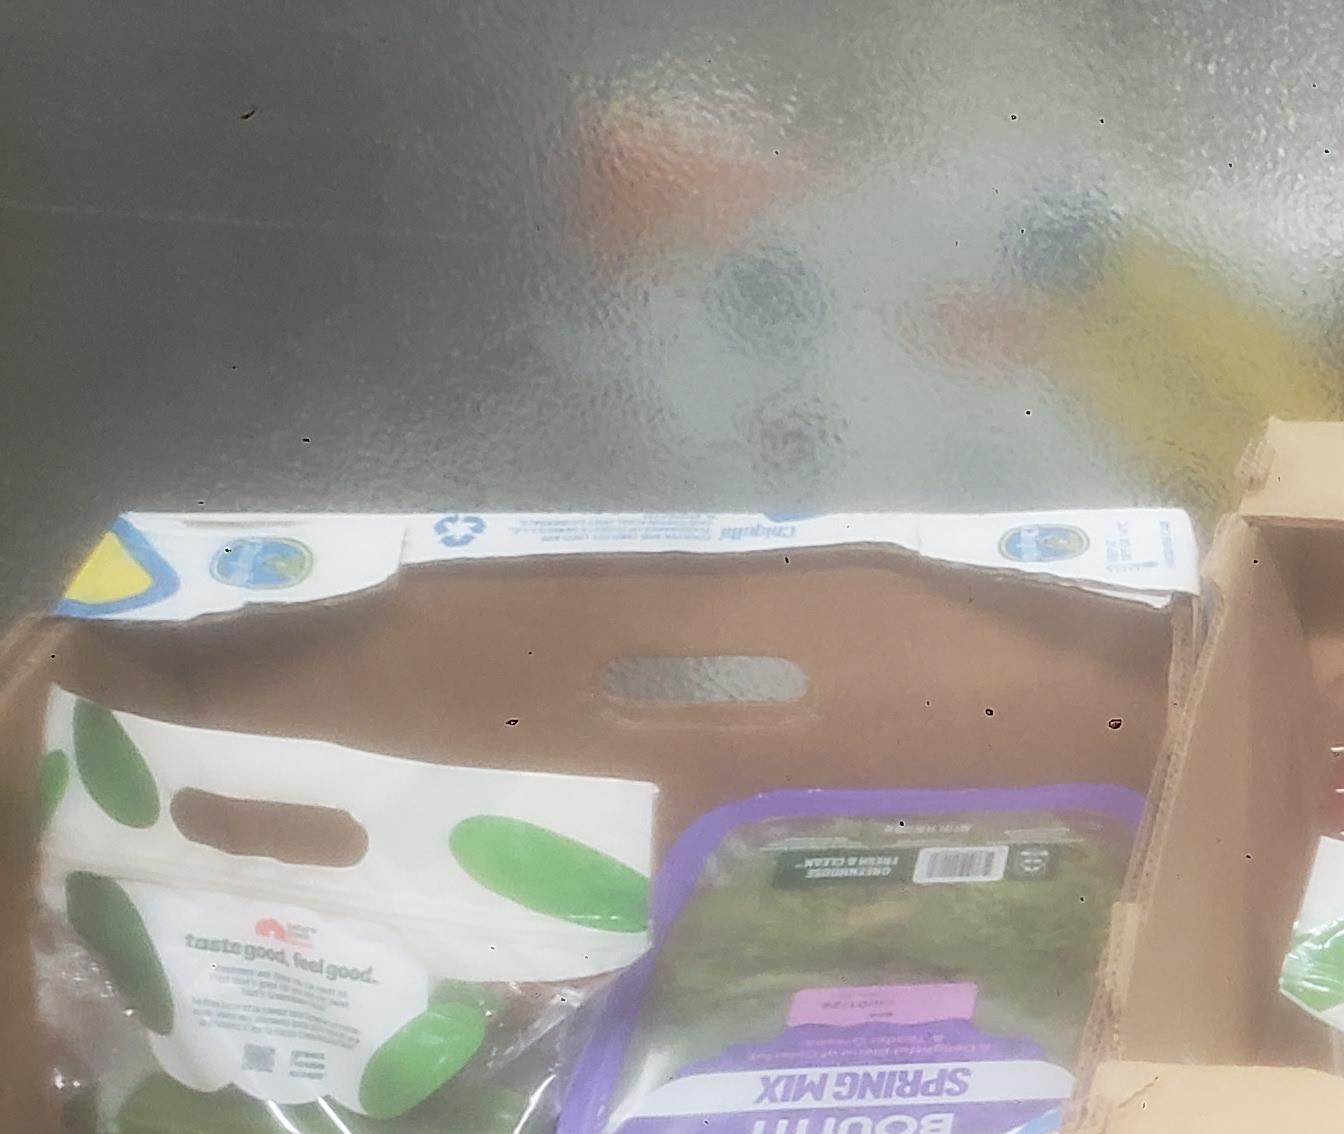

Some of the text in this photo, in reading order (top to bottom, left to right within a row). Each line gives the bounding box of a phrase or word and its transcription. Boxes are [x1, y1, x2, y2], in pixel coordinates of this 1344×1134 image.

[294, 952, 324, 974] feel
[754, 1067, 973, 1104] SPRING MIX
